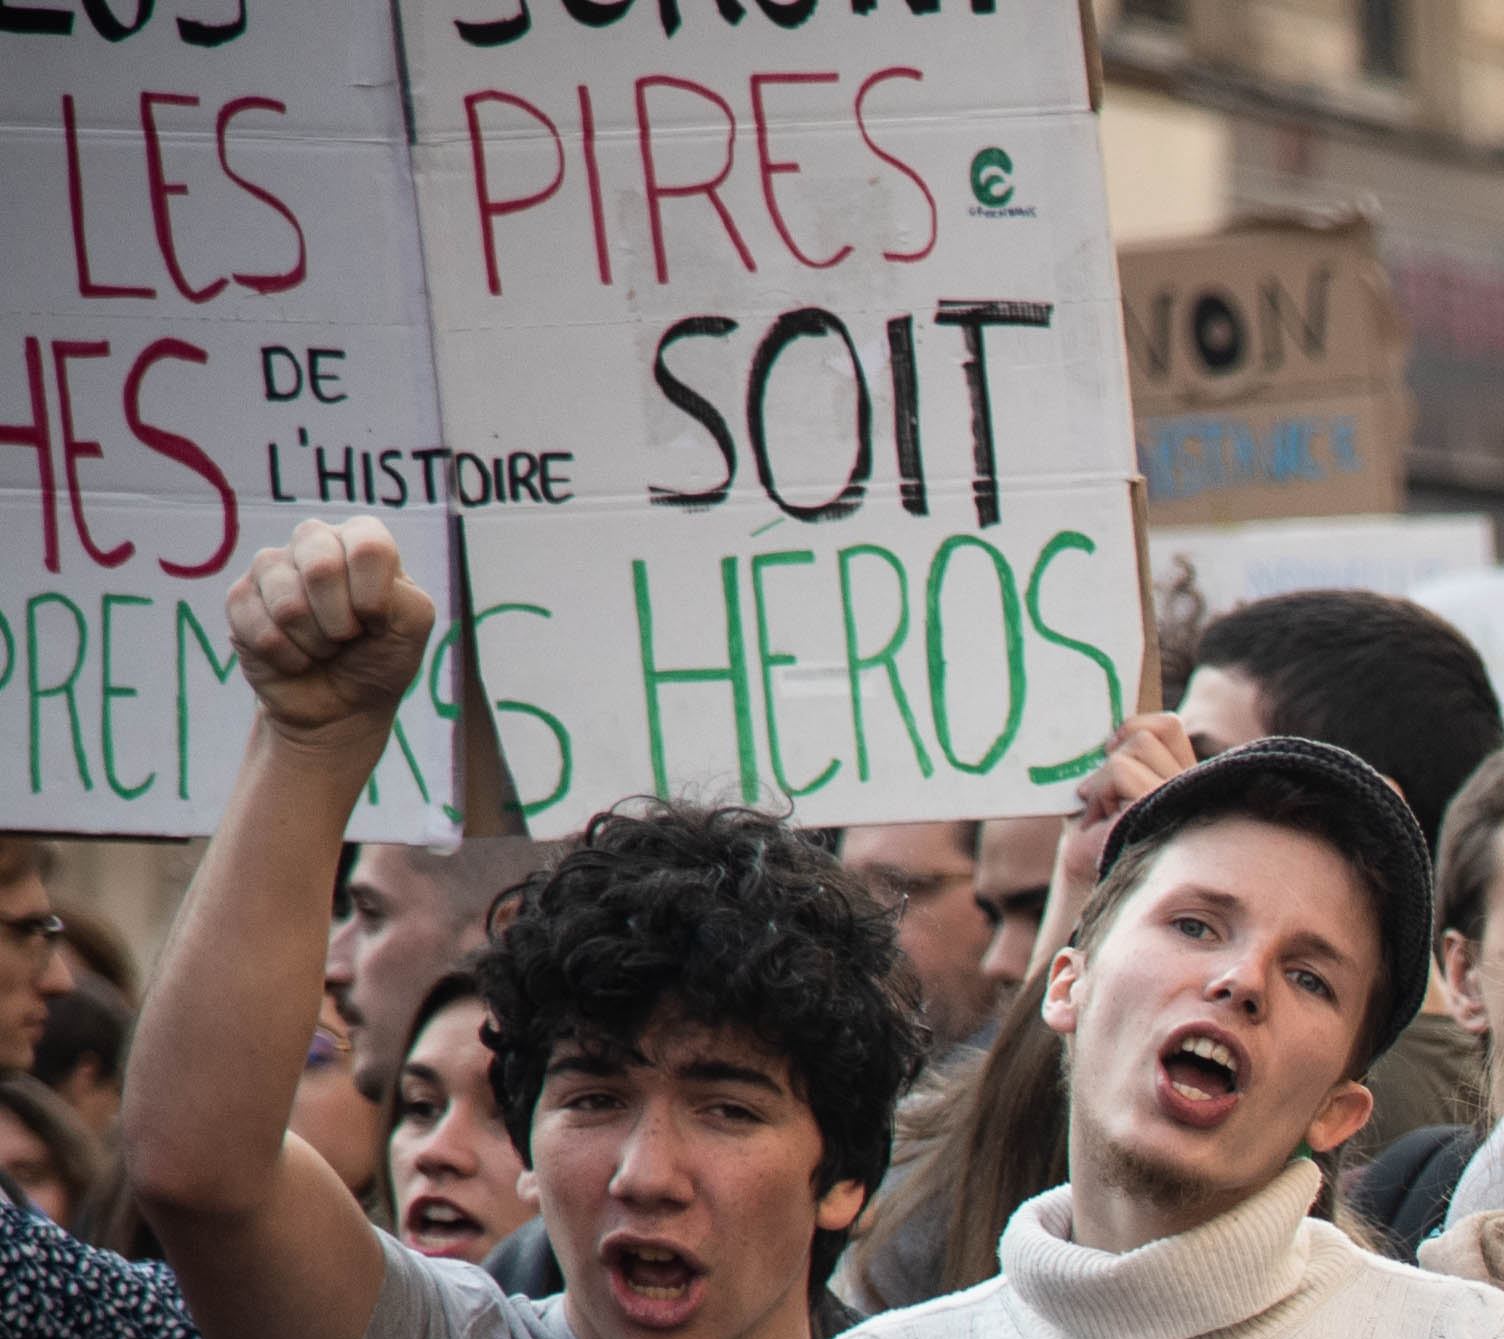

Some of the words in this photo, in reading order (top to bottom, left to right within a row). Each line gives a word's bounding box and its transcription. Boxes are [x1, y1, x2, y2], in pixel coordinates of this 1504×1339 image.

[63, 92, 308, 303] LES
[465, 66, 938, 296] PIRES
[262, 346, 346, 404] DE
[649, 300, 1053, 528] SOIT
[269, 426, 573, 505] L'HISTOIRE
